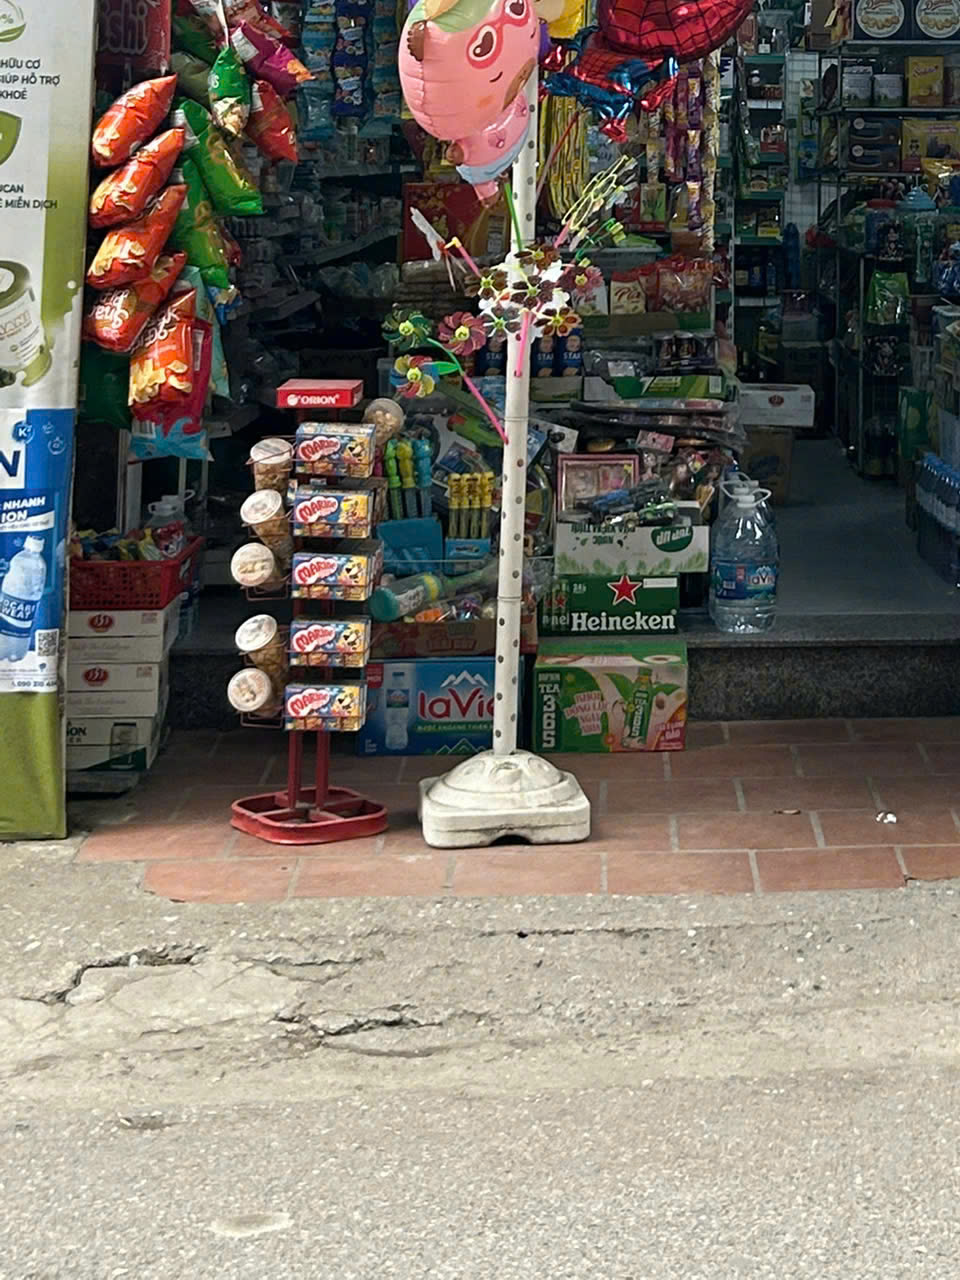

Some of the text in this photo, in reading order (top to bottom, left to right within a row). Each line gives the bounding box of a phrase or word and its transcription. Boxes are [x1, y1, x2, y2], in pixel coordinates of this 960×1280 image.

[300, 394, 336, 405] ORION
[570, 611, 676, 632] Heineken
[538, 684, 560, 694] TEA
[542, 694, 556, 748] 365
